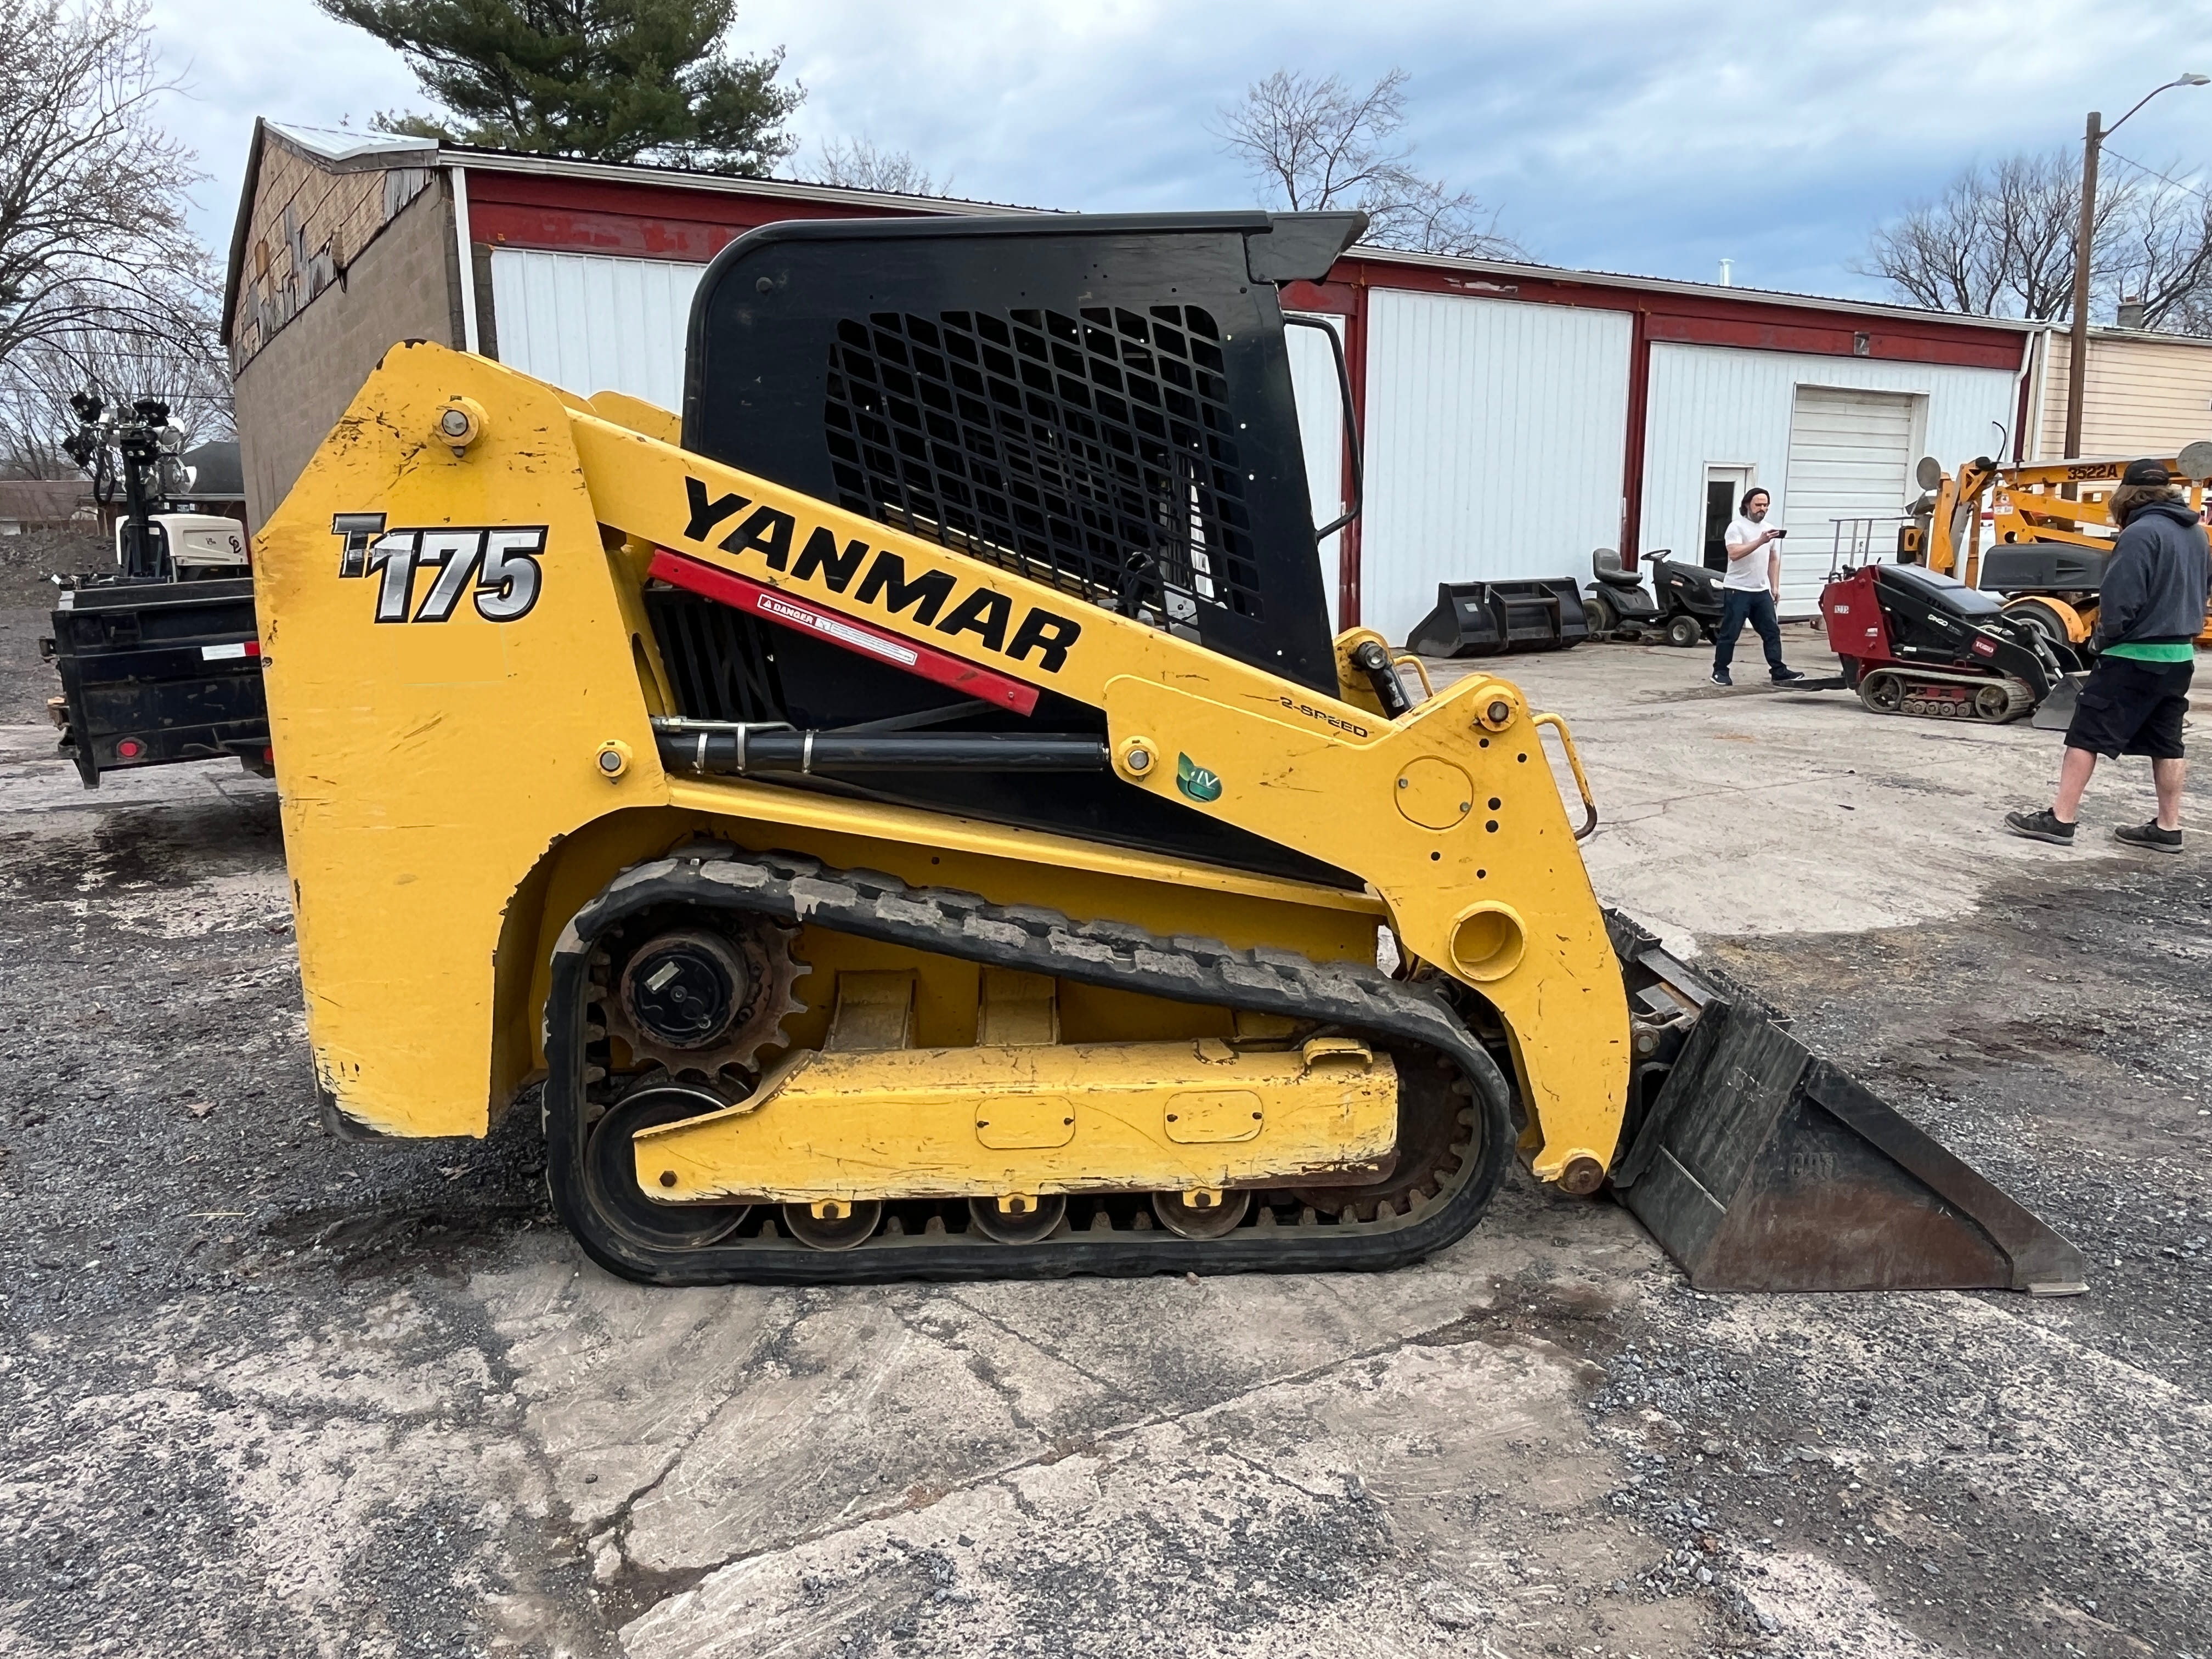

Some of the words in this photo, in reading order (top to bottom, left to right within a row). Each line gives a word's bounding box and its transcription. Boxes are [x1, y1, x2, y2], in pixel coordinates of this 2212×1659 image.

[2067, 464, 2118, 480] 3522A
[684, 476, 1082, 673] YANMAR
[773, 605, 814, 625] DANGER
[1280, 696, 1368, 738] 2-SPEED
